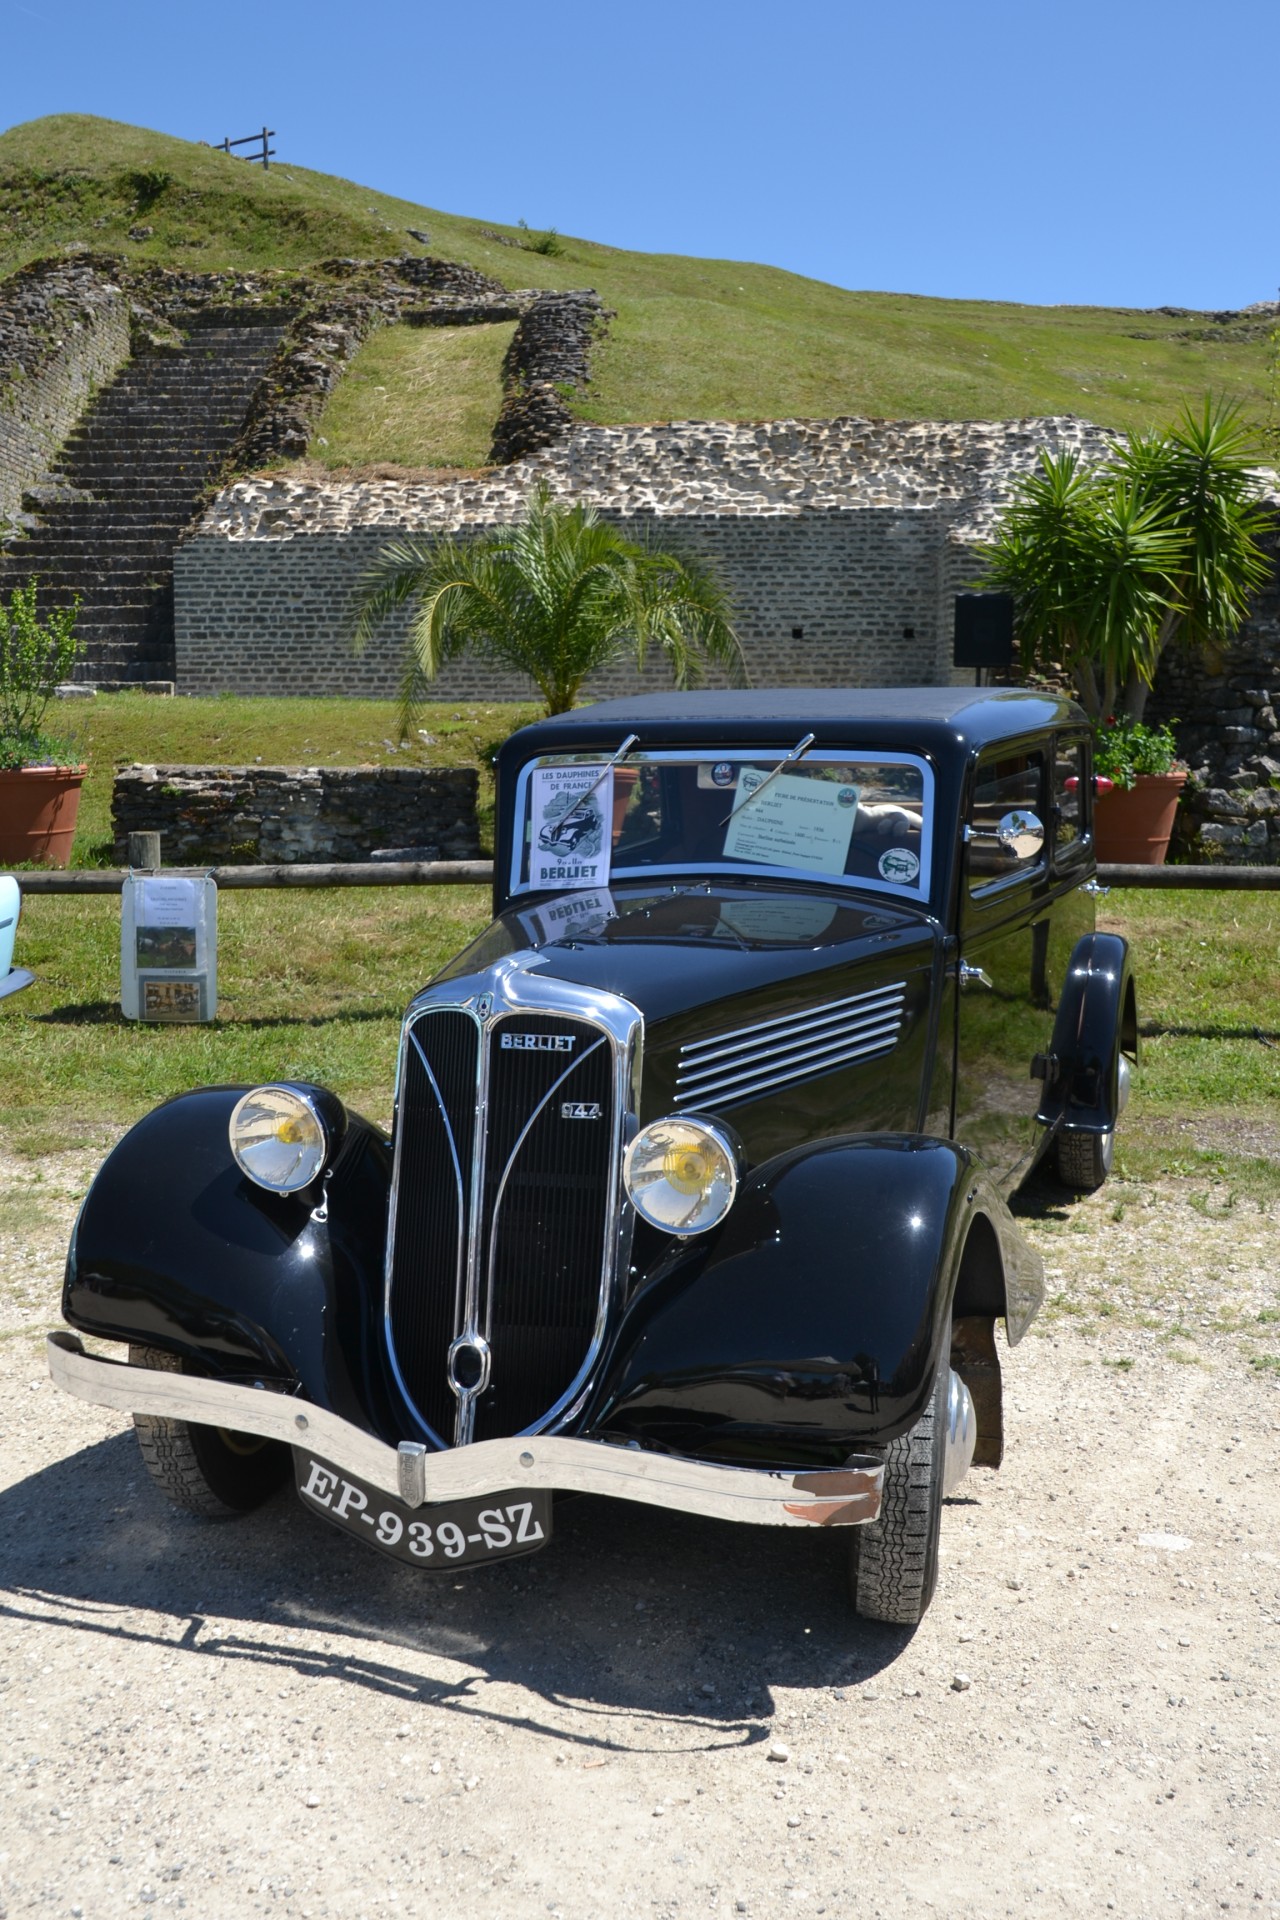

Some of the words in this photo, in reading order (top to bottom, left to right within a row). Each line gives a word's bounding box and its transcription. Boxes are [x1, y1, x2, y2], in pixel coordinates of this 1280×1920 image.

[556, 770, 599, 779] DAUPHINES
[563, 782, 592, 790] FRANCE
[540, 865, 598, 880] BERLIET
[501, 1033, 576, 1051] BERLIET
[300, 1460, 544, 1558] EP-939-SZ
